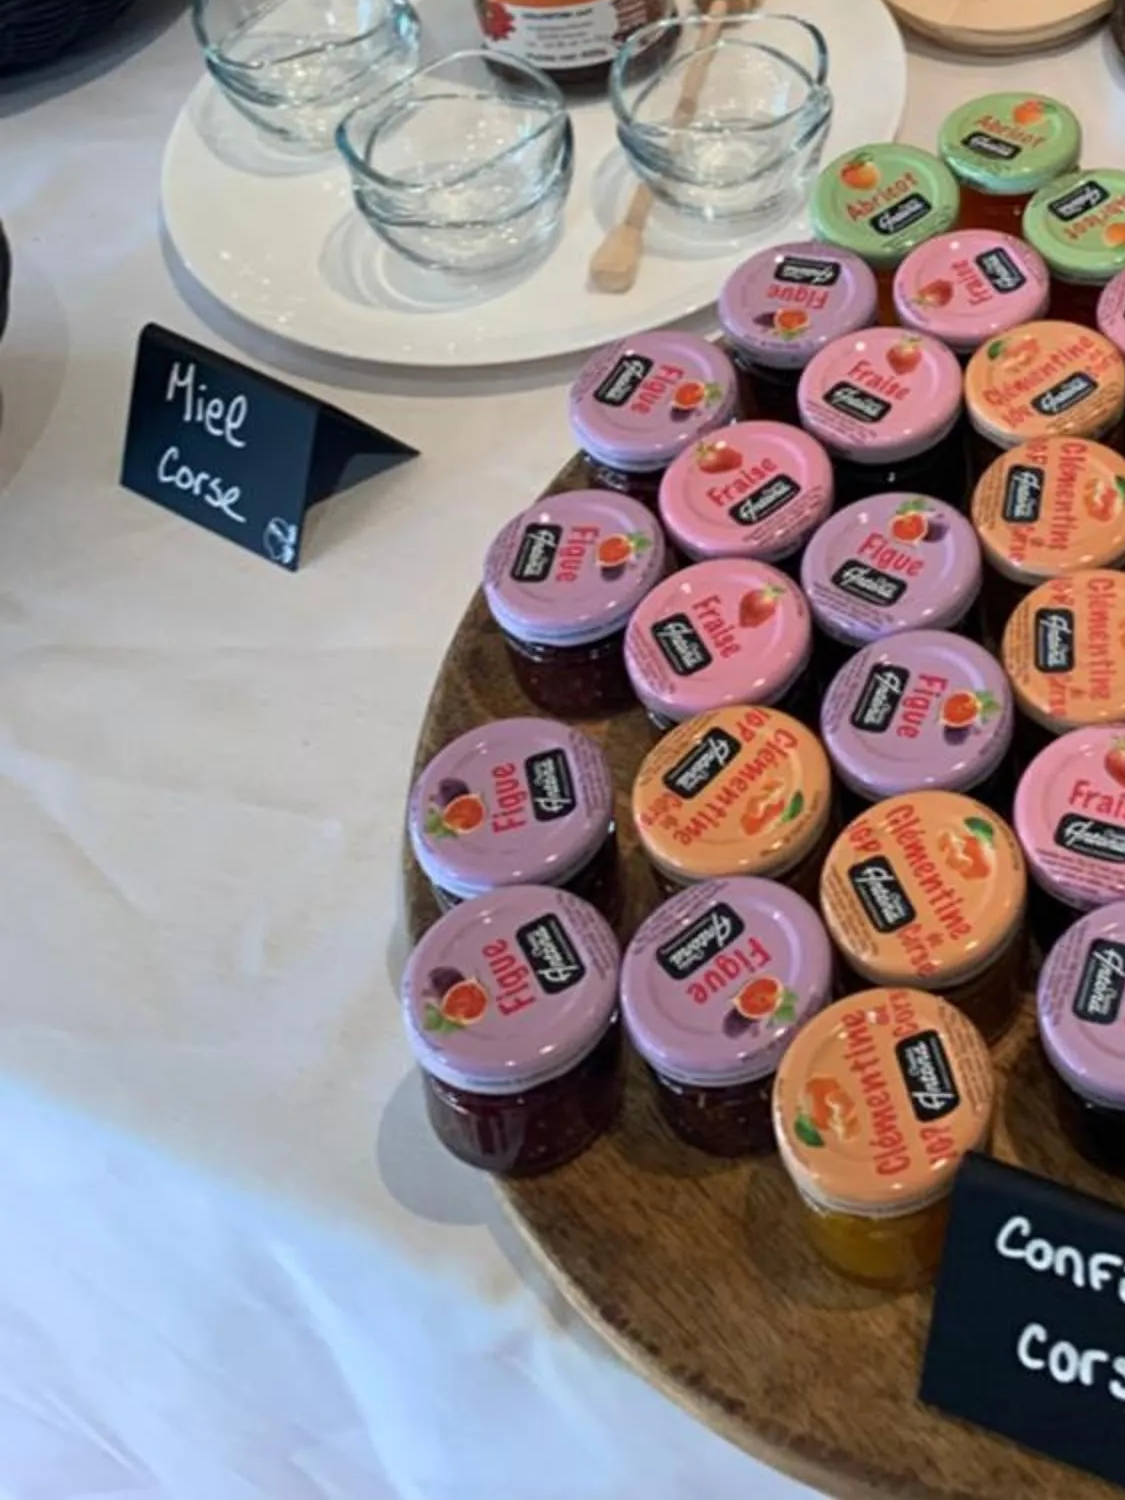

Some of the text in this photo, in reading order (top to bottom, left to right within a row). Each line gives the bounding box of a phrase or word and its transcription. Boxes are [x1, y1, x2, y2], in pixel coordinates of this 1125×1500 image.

[768, 284, 830, 310] Figue
[165, 361, 248, 449] Miel
[631, 364, 684, 414] Figue
[848, 360, 910, 400] Fraise
[157, 446, 248, 524] Corse
[707, 458, 778, 507] Fraise
[556, 526, 600, 582] Figue
[858, 534, 924, 576] Figue
[692, 596, 740, 659] Fraise
[898, 674, 947, 738] Figue
[492, 764, 527, 833] Figue
[482, 939, 536, 1016] Figue
[686, 938, 771, 1005] Figue
